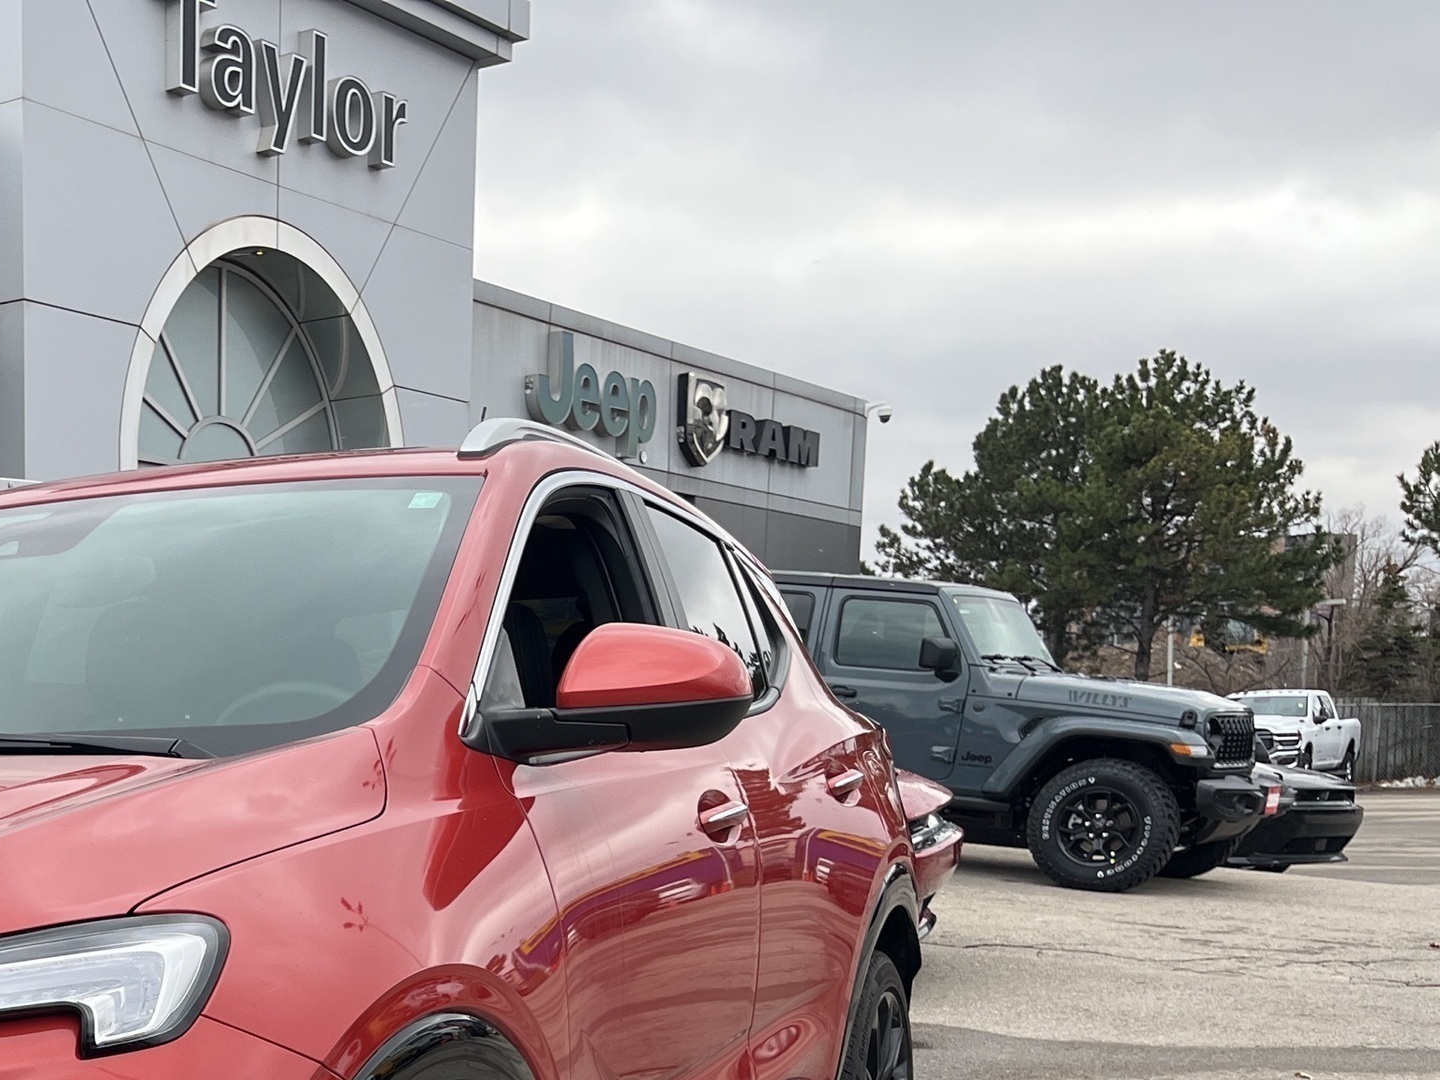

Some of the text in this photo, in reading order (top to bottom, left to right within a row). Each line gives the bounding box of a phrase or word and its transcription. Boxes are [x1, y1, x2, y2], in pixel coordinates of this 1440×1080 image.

[166, 0, 407, 169] Taylor
[525, 331, 657, 458] Jeep
[725, 409, 820, 467] RAM
[961, 750, 993, 765] Jeep
